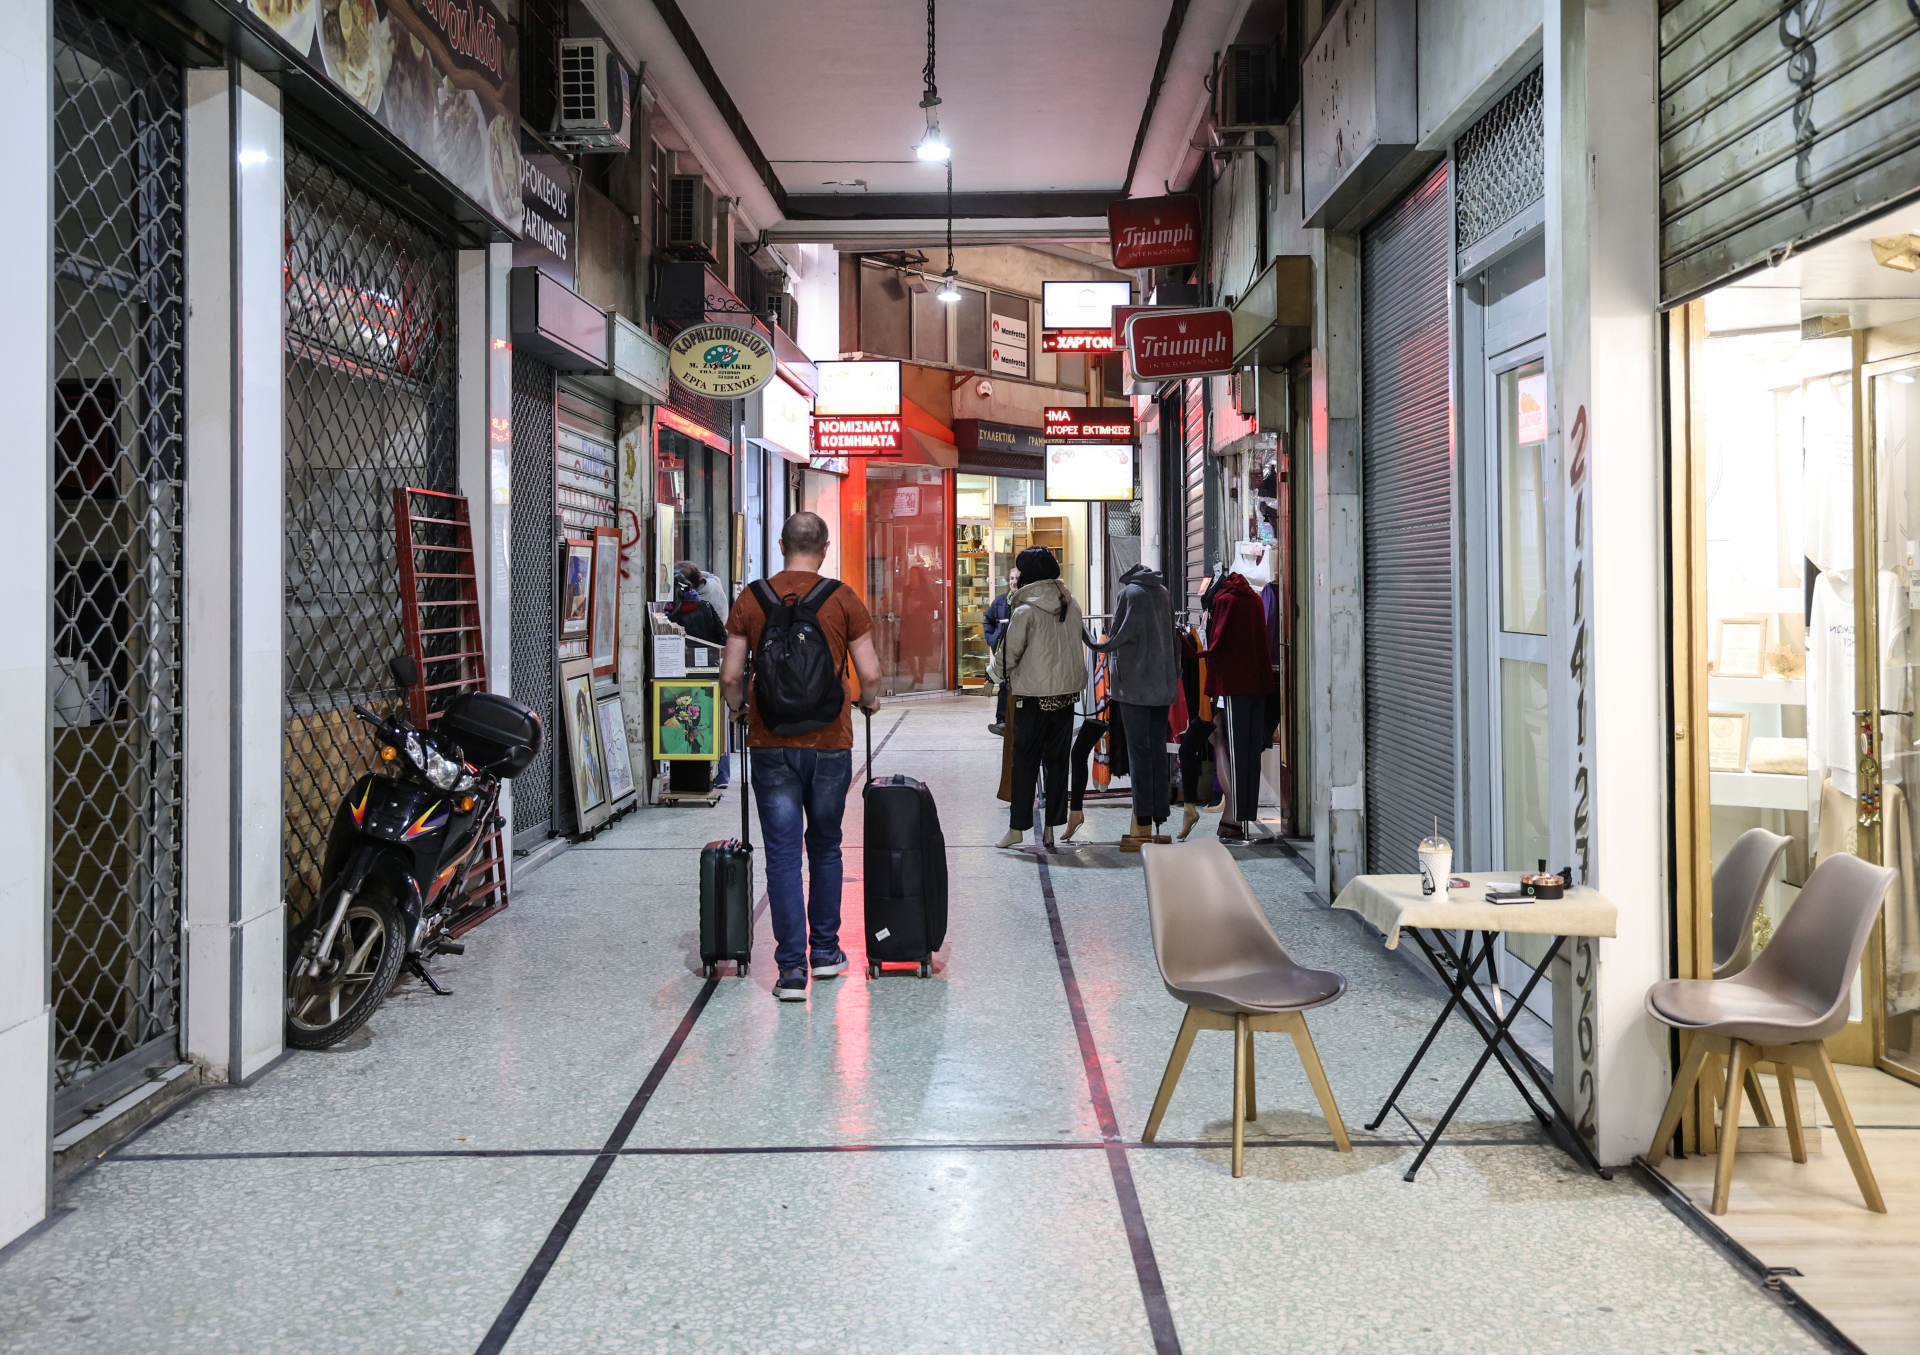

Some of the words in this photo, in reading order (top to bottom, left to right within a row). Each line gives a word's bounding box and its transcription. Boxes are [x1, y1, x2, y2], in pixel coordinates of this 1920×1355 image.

[1122, 223, 1194, 248] Triumph
[1129, 248, 1191, 258] INTERNATIONAL
[673, 326, 769, 358] ΚΟΡΝΙΖΟΠΟΙΕΙΟΝ
[1140, 331, 1227, 358] Triumph
[1149, 357, 1225, 369] INTERNATIONAL
[682, 372, 707, 389] ΕΡΓΑ
[713, 375, 758, 392] ΤΕΧΝΗΣ
[818, 420, 900, 433] ΝΟΜΙΣΜΑΤΑ
[1082, 425, 1131, 435] ΕΚΤΙΜΗΣΕΙΣ
[820, 434, 896, 447] ΚΟΣΜΗΜΑΤΑ
[979, 429, 1016, 444] ΣΥΛΛΕΚΤΙΚΑ
